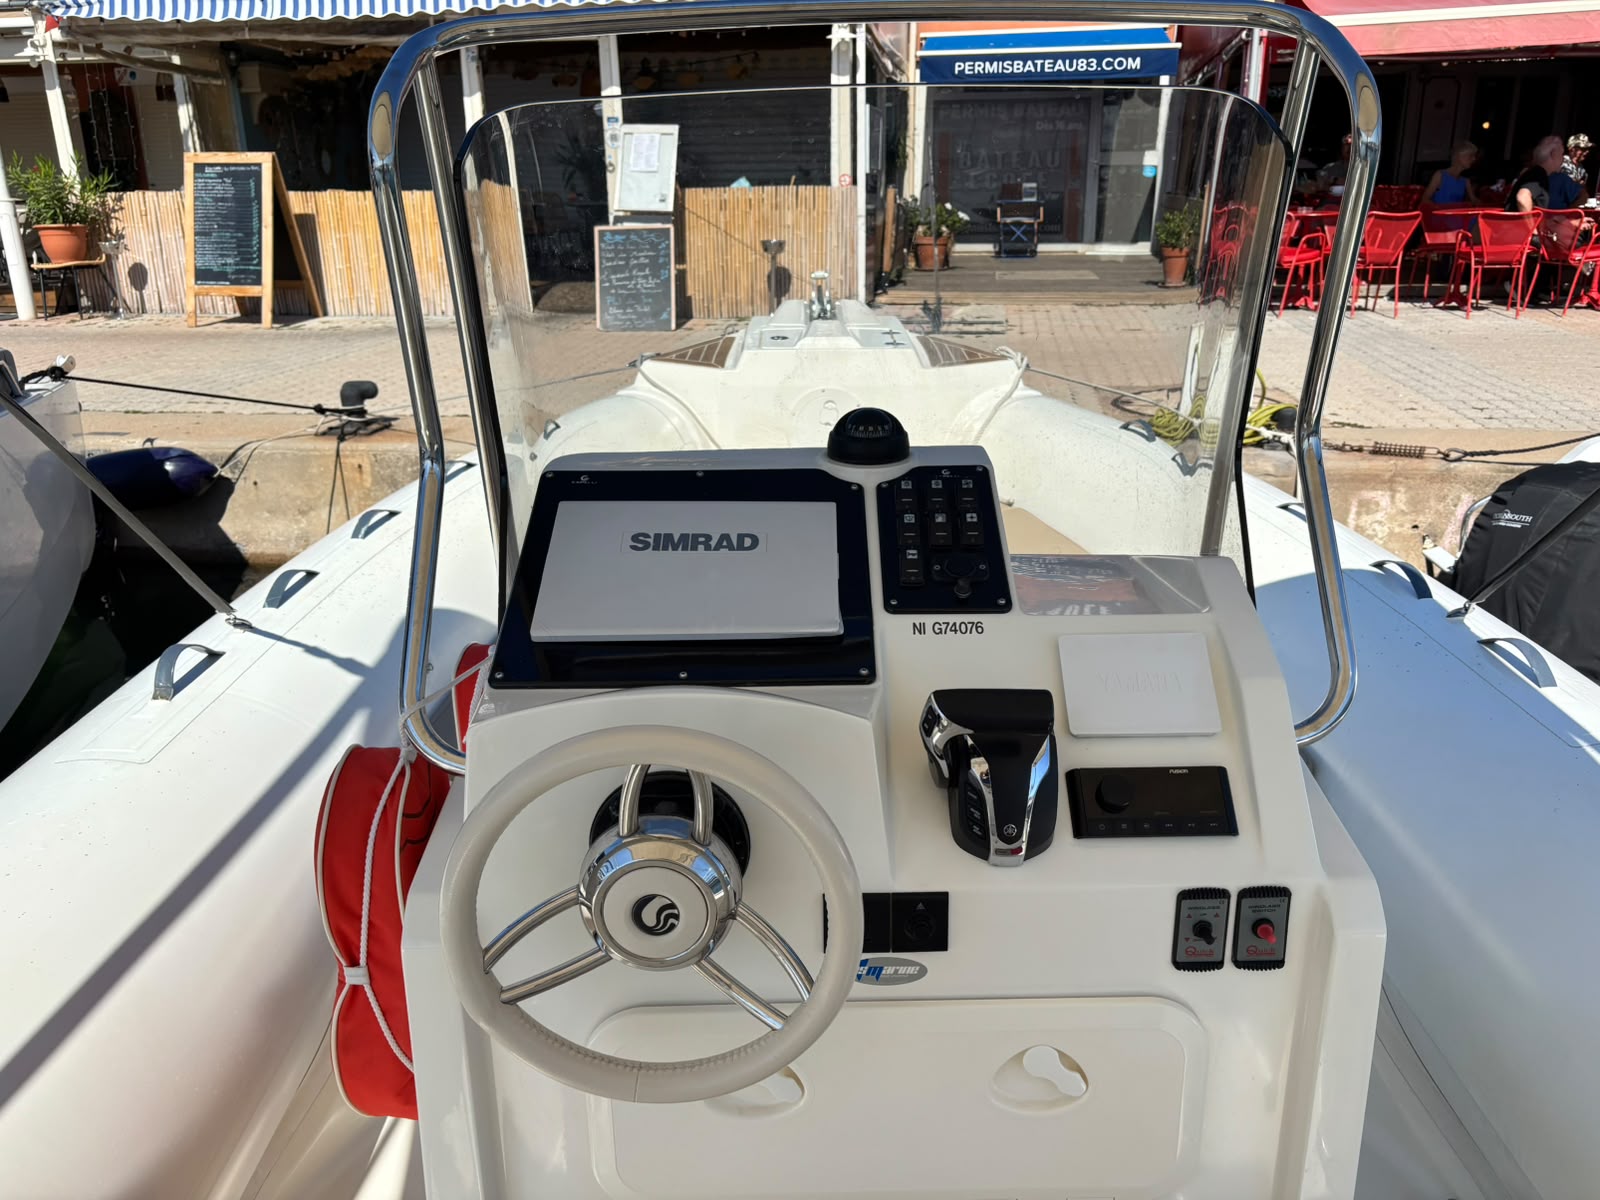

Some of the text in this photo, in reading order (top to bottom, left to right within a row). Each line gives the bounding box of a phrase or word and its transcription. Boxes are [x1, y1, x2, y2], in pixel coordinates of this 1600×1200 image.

[954, 56, 1142, 75] PERMISBATEAU83.COM
[958, 150, 1061, 169] BATEAU
[629, 532, 760, 552] SIMRAD
[912, 621, 985, 635] NI G74076
